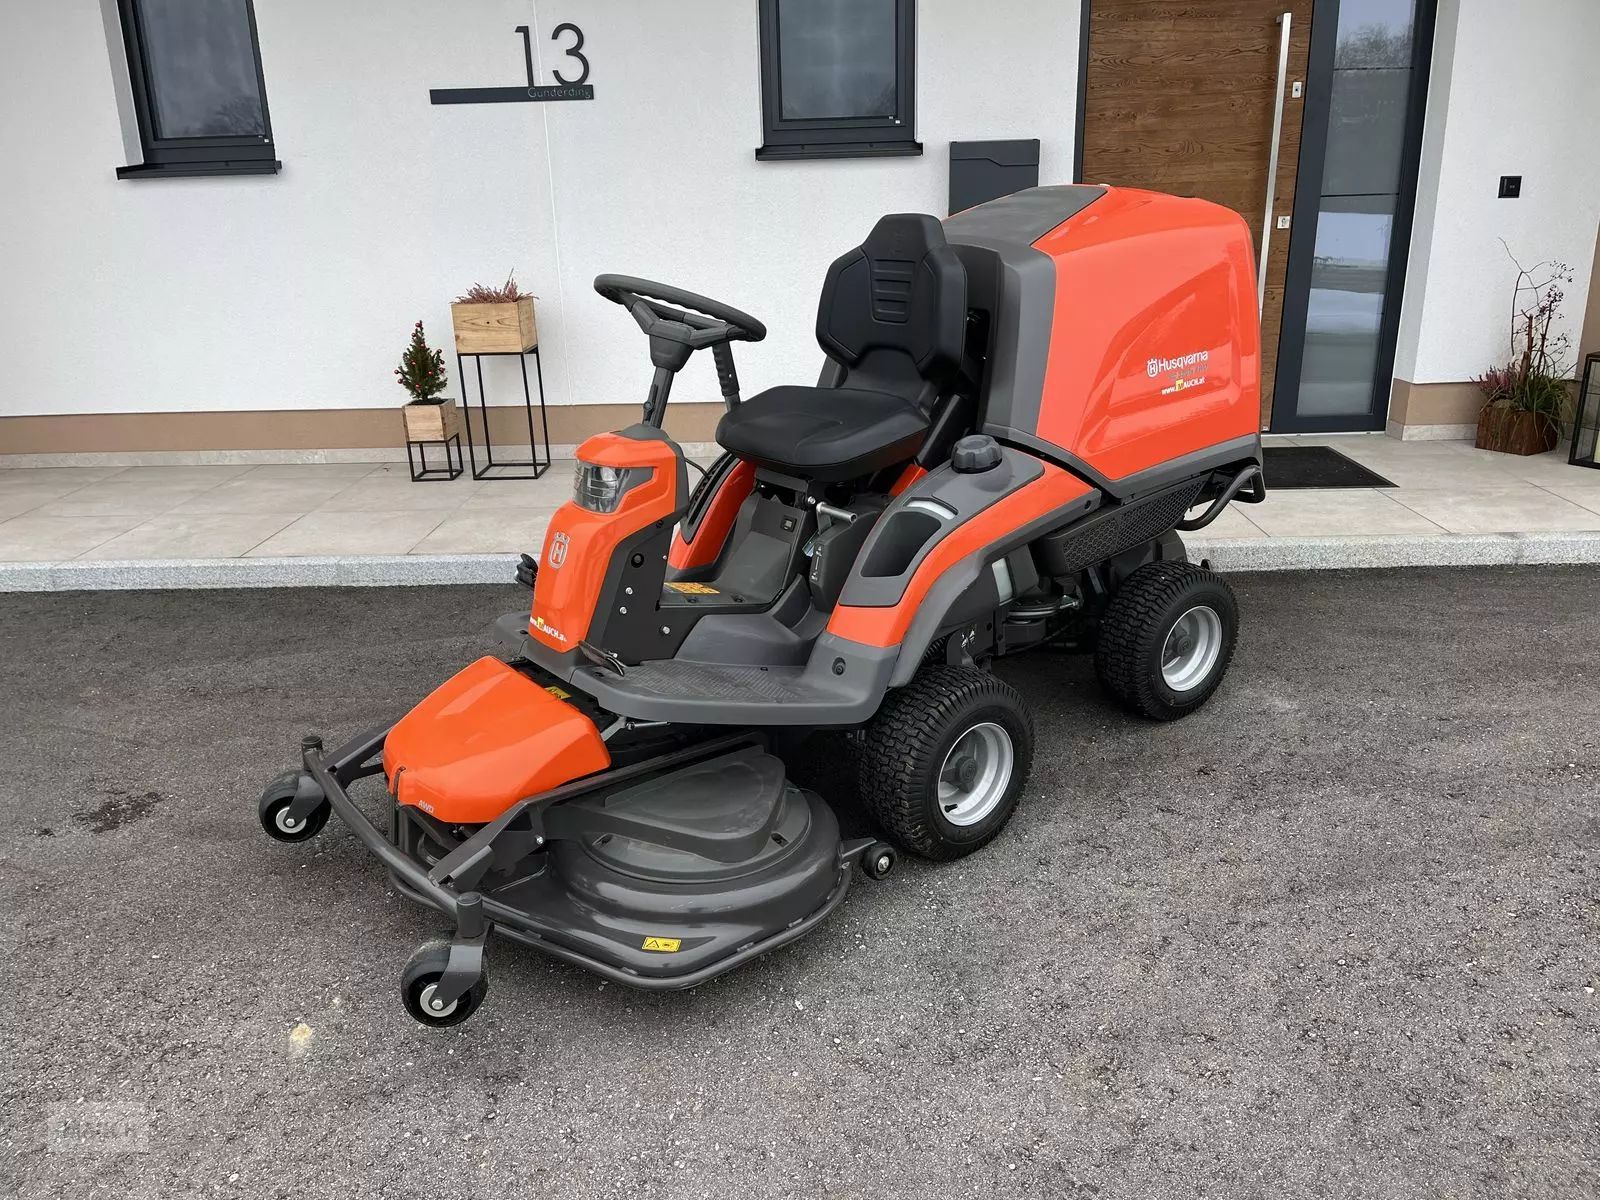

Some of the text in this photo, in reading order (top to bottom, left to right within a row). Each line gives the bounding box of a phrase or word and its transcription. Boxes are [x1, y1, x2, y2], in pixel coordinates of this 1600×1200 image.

[514, 22, 590, 87] 13
[527, 86, 591, 99] Gunderding
[1158, 350, 1208, 372] Husqvarna
[417, 799, 434, 815] AWD
